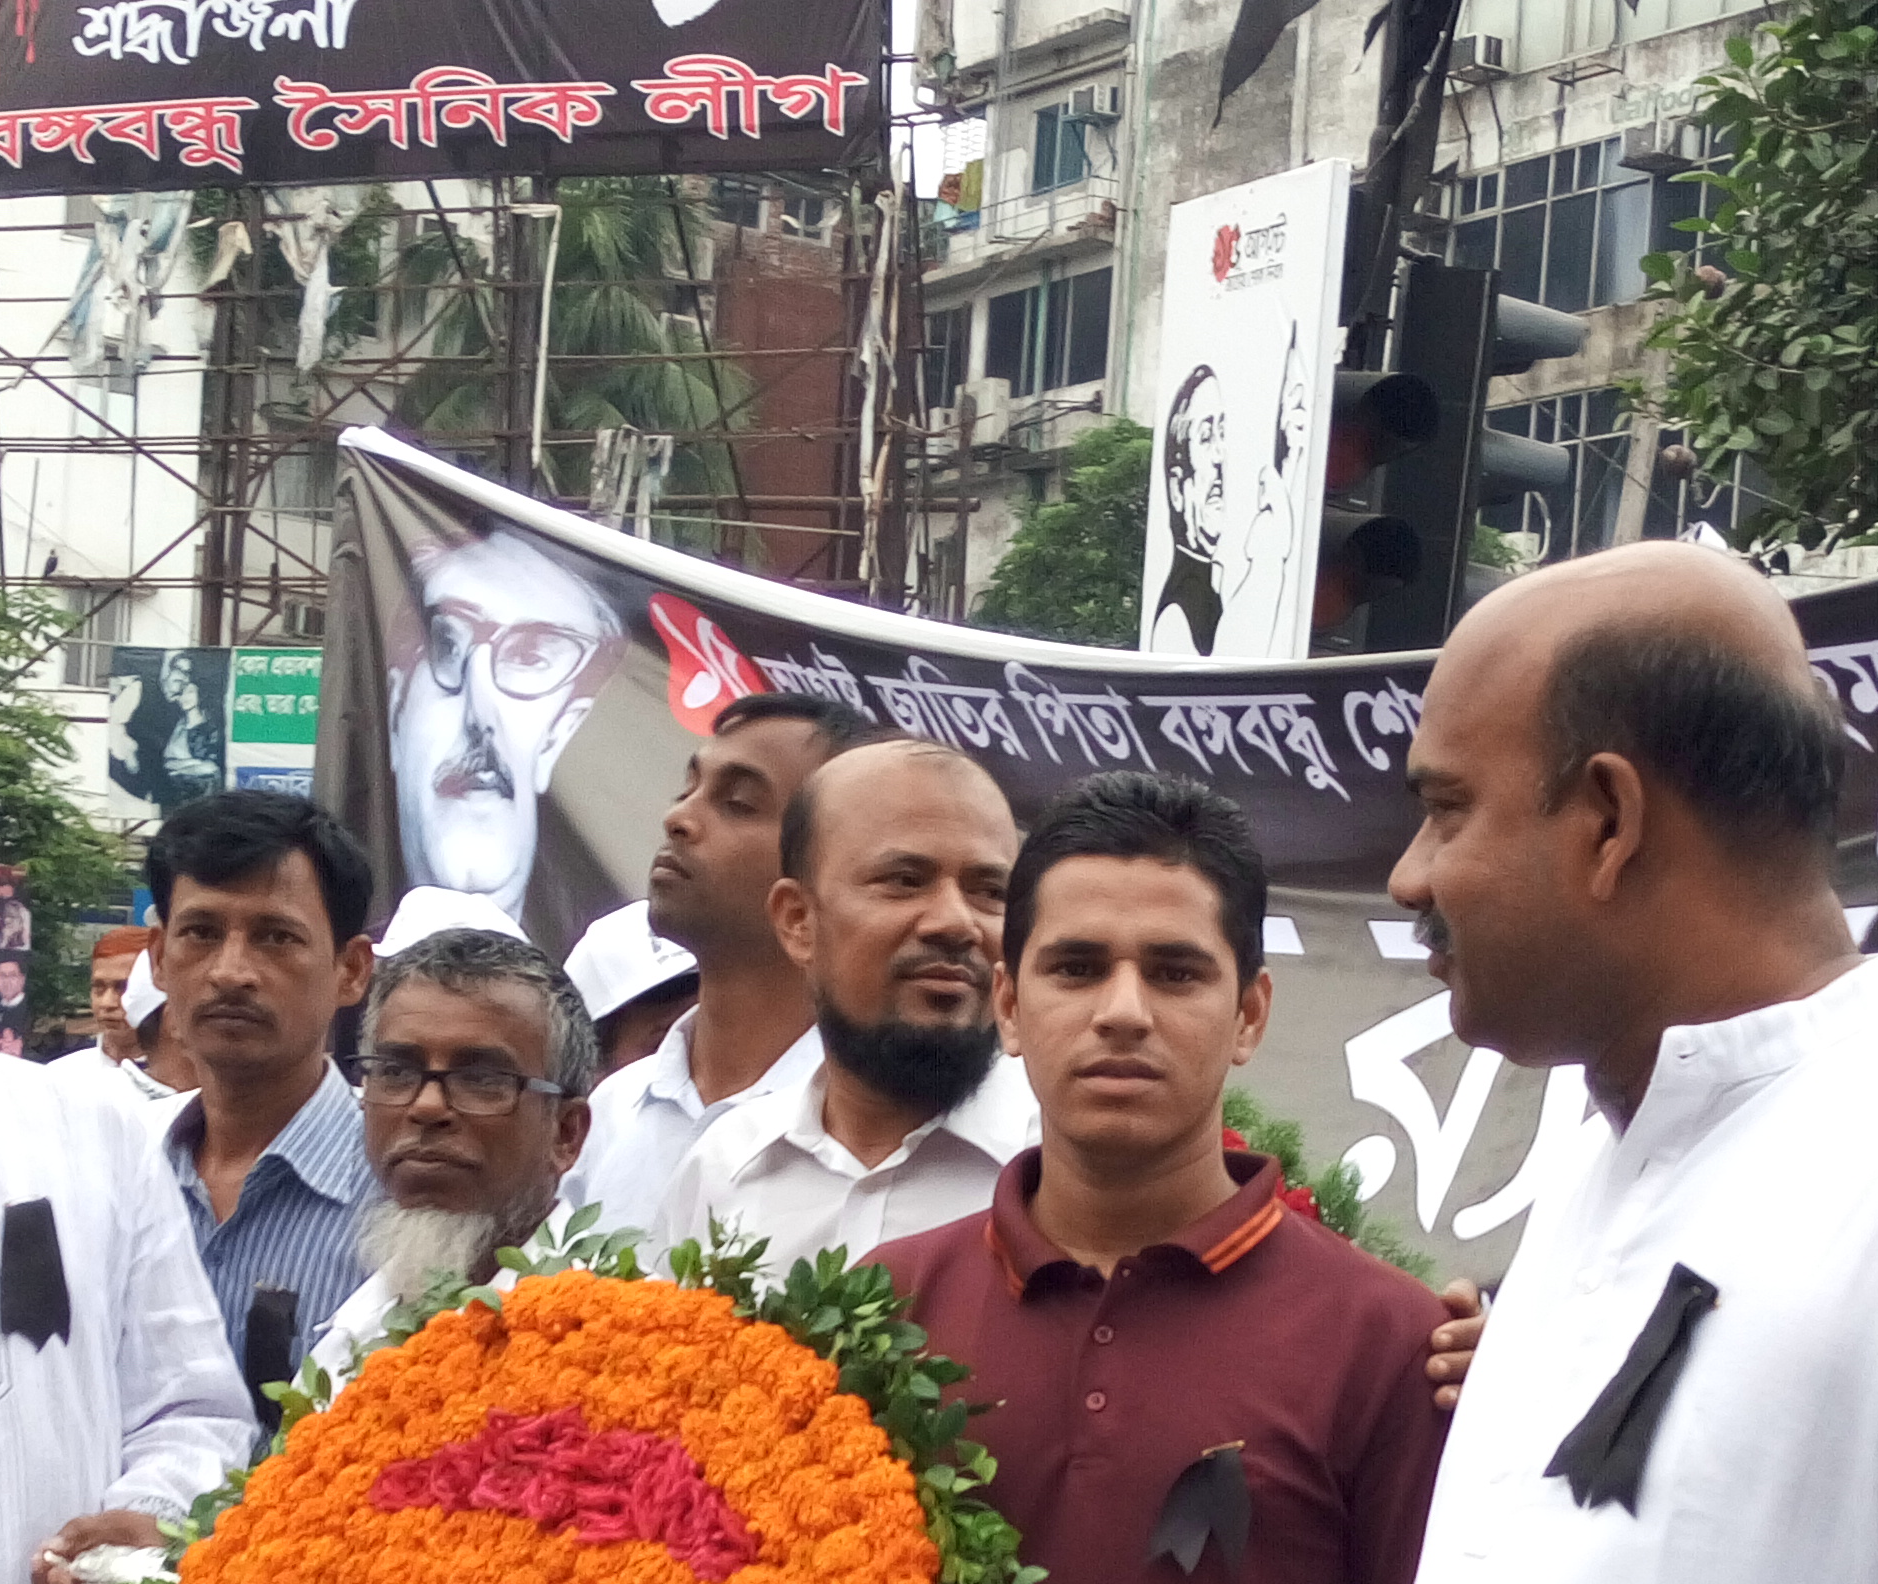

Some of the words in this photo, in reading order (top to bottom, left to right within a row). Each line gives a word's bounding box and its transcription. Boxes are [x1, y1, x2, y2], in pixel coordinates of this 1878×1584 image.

[272, 65, 618, 150] সৈনিক
[630, 53, 871, 138] লীগ
[863, 655, 1031, 762] জাতির
[1003, 660, 1157, 772] পিতা
[1137, 693, 1352, 801] বঙ্গবন্ধু
[1343, 676, 1424, 772] শে
